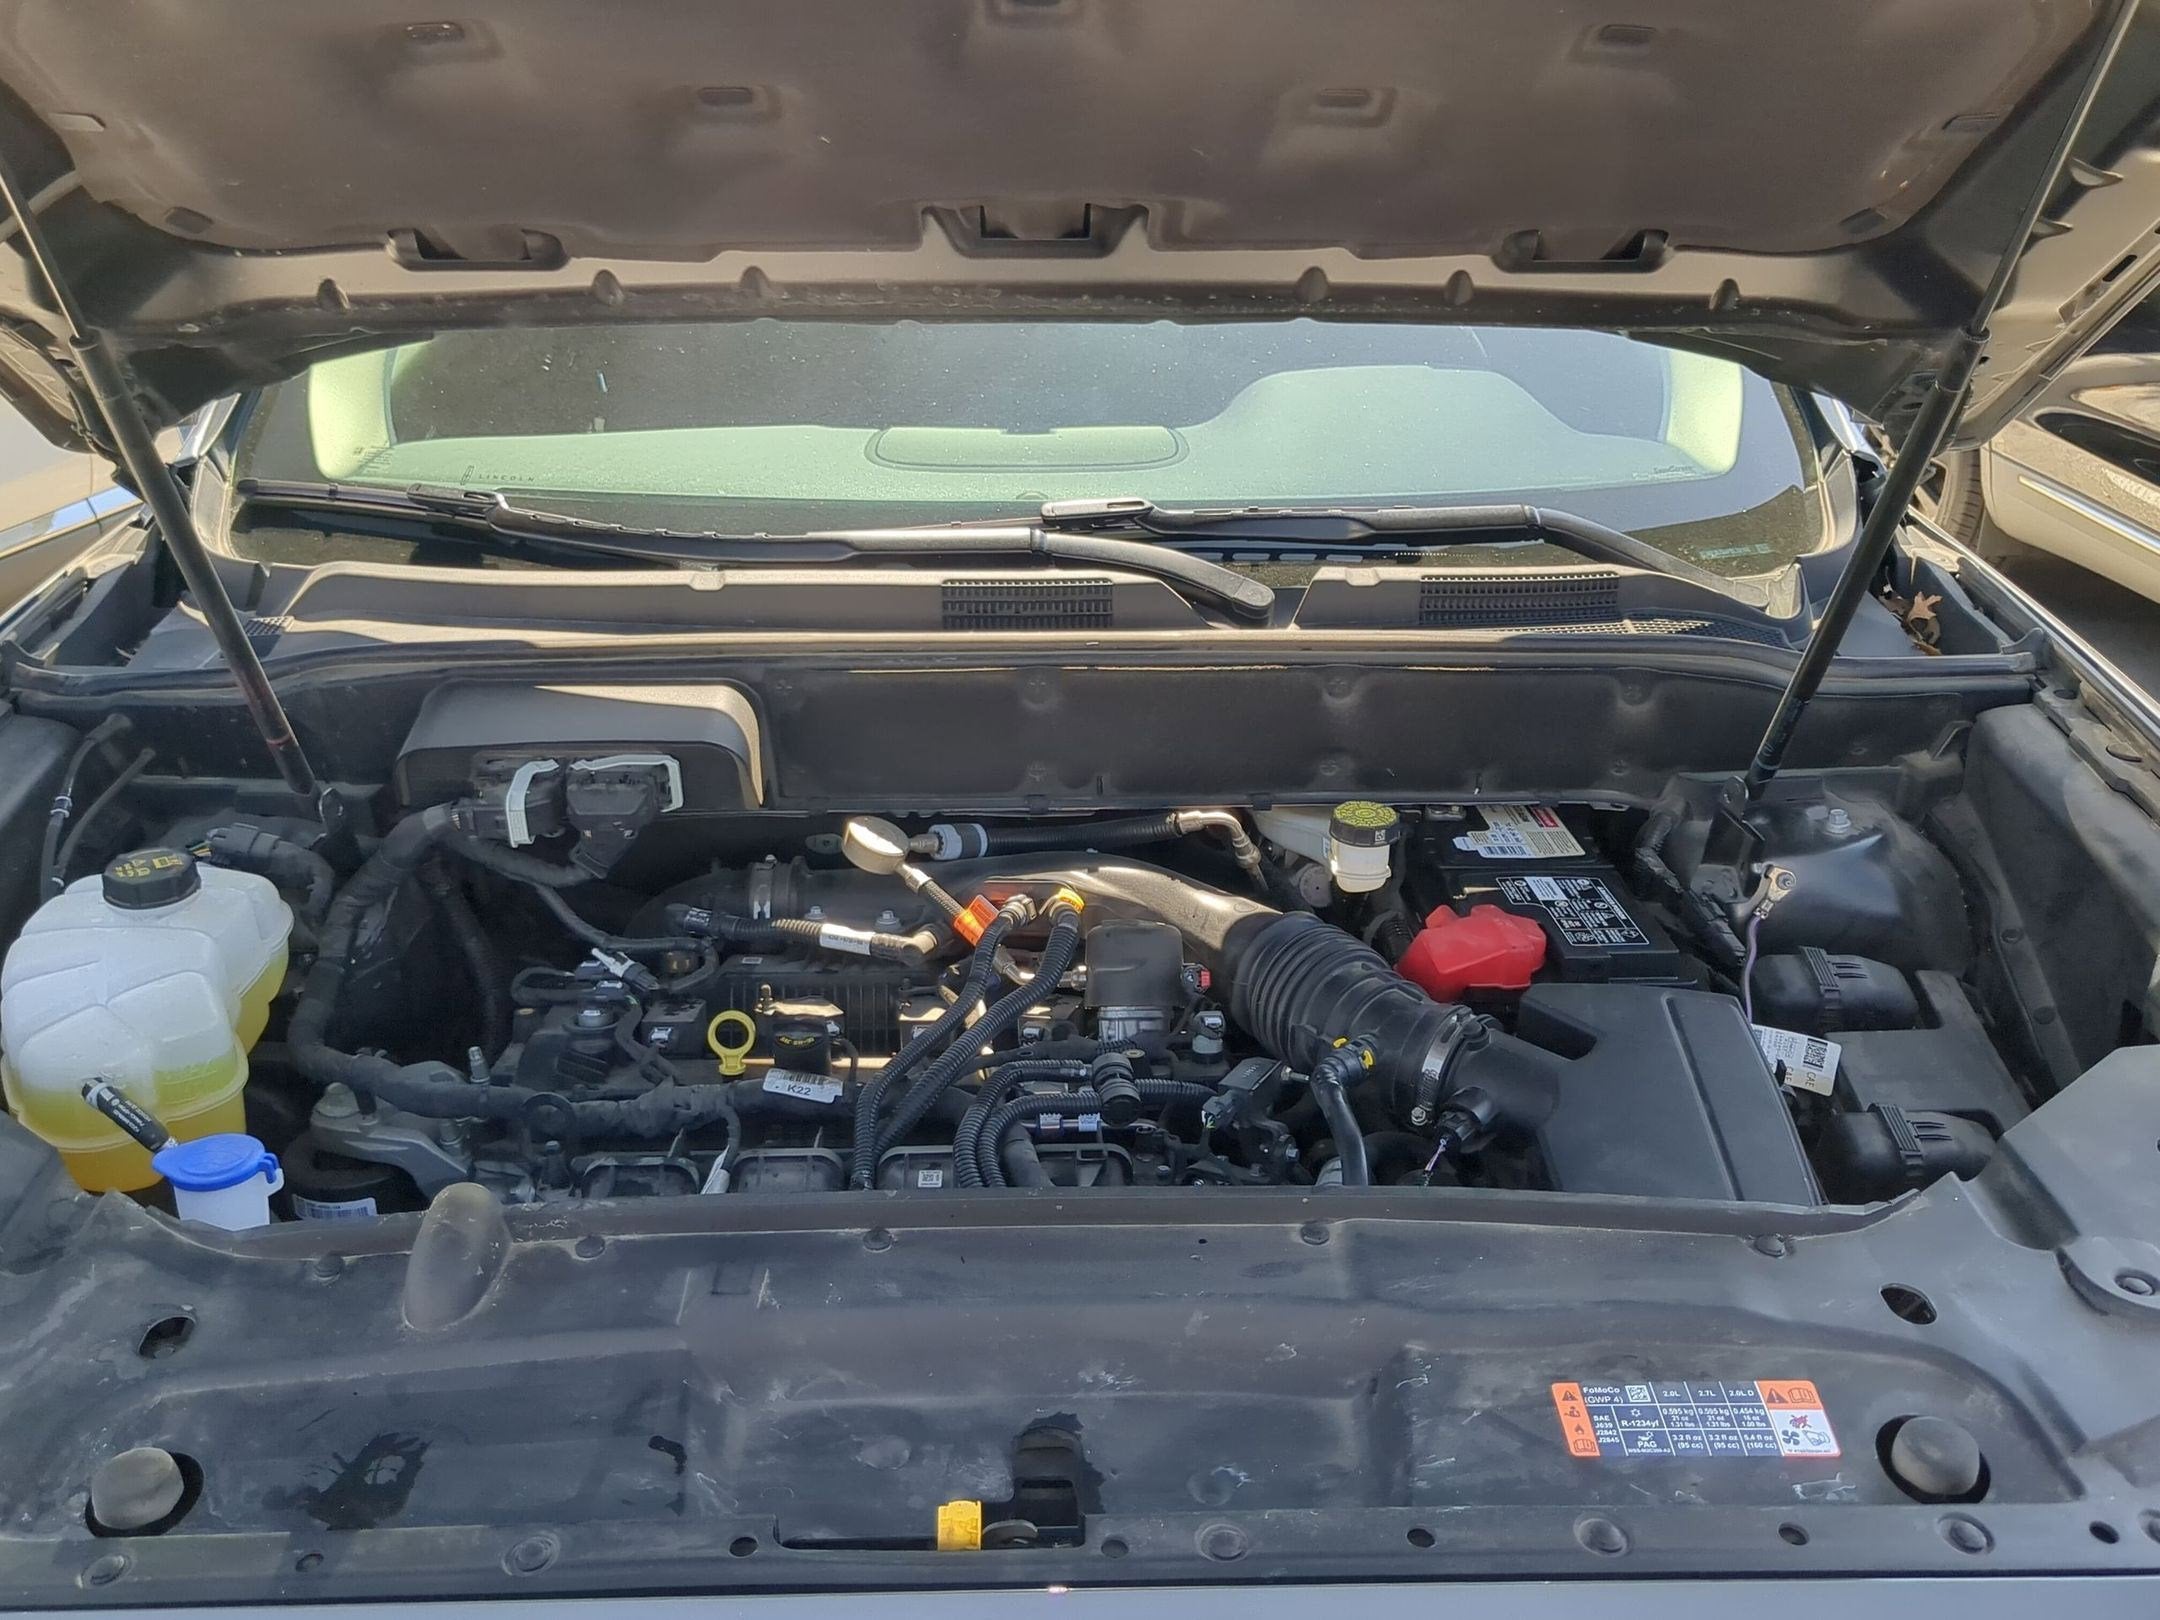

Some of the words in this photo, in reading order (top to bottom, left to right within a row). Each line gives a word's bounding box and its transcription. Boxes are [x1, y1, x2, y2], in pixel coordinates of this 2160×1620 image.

[478, 474, 535, 482] LINCOLN
[787, 1084, 811, 1095] K22
[1583, 1386, 1620, 1394] FoMoCo
[1584, 1396, 1611, 1404] (GWP
[1684, 1408, 1695, 1416] kg
[1720, 1408, 1730, 1416] kg
[1754, 1408, 1765, 1416] kg
[1637, 1440, 1657, 1448] PAG
